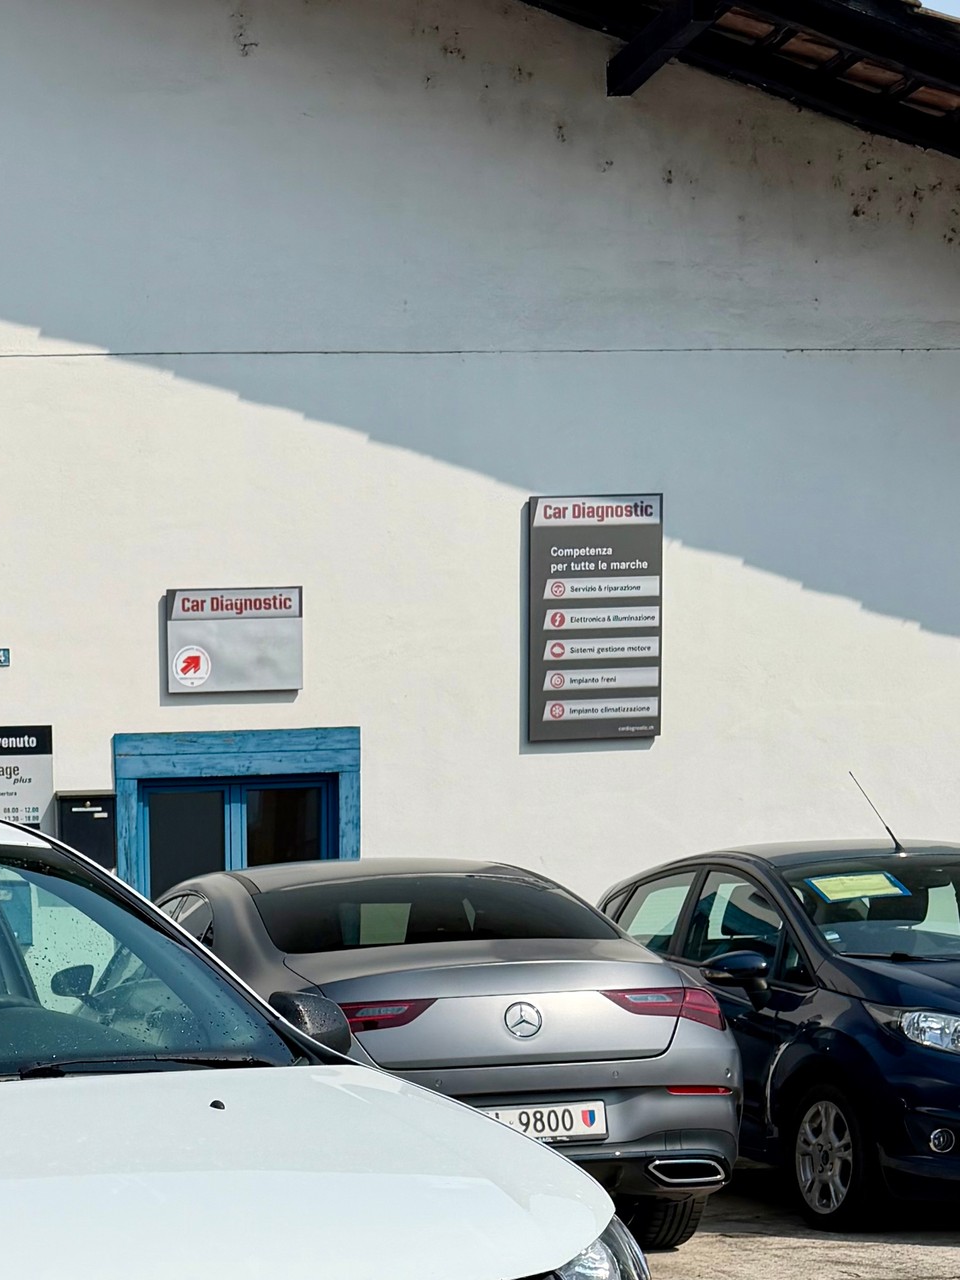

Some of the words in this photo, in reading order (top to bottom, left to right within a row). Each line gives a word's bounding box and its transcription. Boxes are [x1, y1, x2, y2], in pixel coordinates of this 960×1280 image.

[543, 504, 567, 521] Car
[572, 501, 653, 522] Diagnostic
[550, 546, 613, 559] Competenza
[550, 562, 567, 574] per
[570, 561, 595, 571] tutte
[598, 560, 607, 570] le
[610, 559, 648, 570] marche
[570, 584, 596, 592] Servizio
[603, 584, 641, 593] riparazione
[181, 597, 206, 612] Car
[210, 594, 292, 615] Diagnostic
[570, 615, 606, 624] Elettronica
[612, 614, 655, 623] illuminazione
[570, 646, 594, 654] Sistemi
[596, 646, 625, 655] gestione
[627, 645, 651, 653] motore
[569, 676, 599, 685] Impianto
[600, 675, 616, 683] freni
[569, 707, 599, 715] Impianto
[600, 705, 650, 714] climatizzazione
[13, 776, 32, 785] plus
[519, 1108, 574, 1133] 9800
